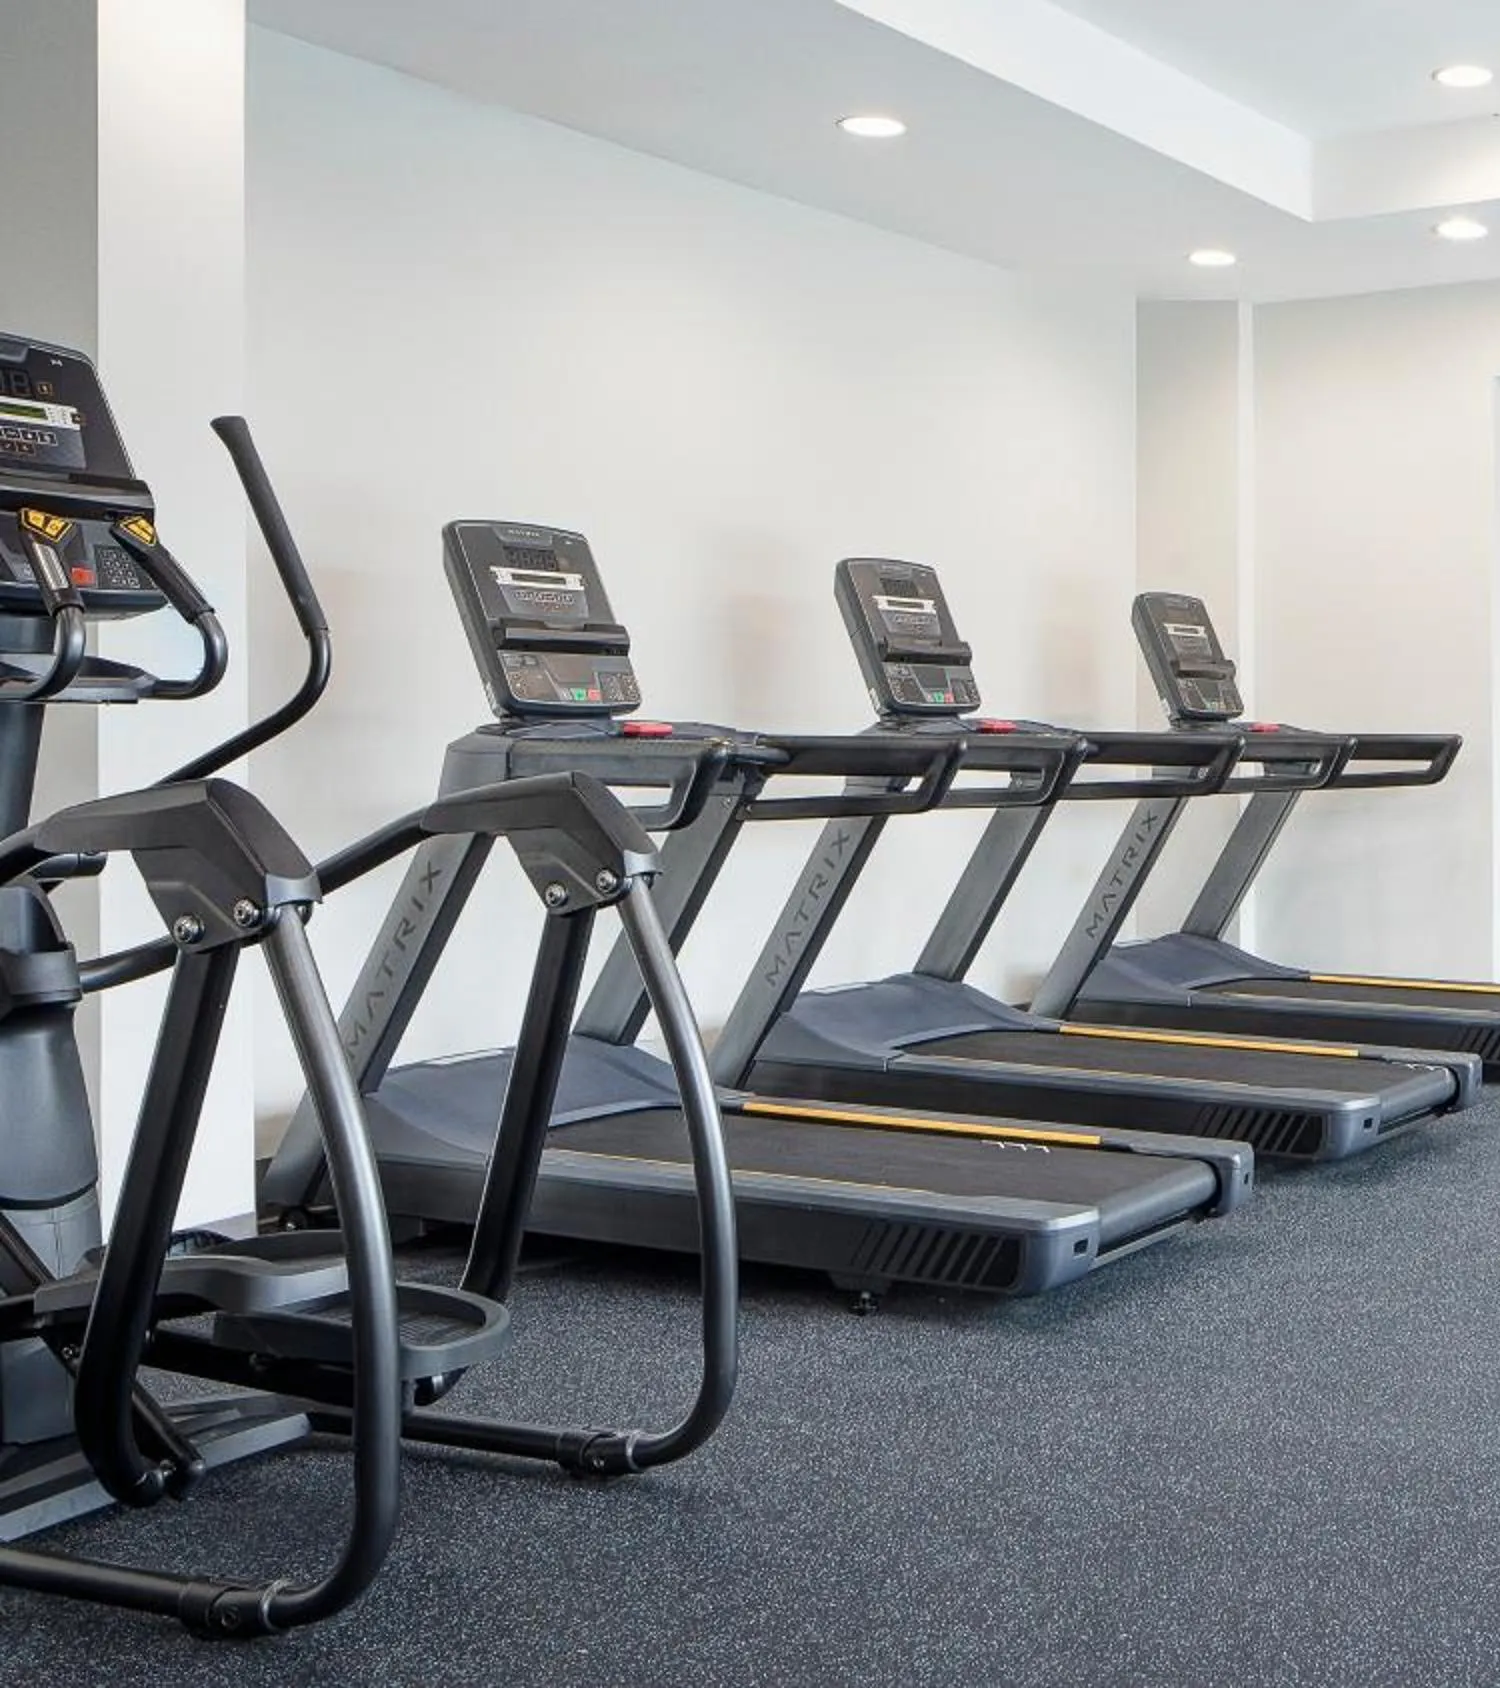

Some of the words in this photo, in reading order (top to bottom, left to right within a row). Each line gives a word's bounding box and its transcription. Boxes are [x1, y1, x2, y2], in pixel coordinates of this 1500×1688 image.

[765, 828, 850, 988] MATRIX
[1086, 809, 1158, 938] MATRIX
[344, 860, 442, 1060] MATRIX
